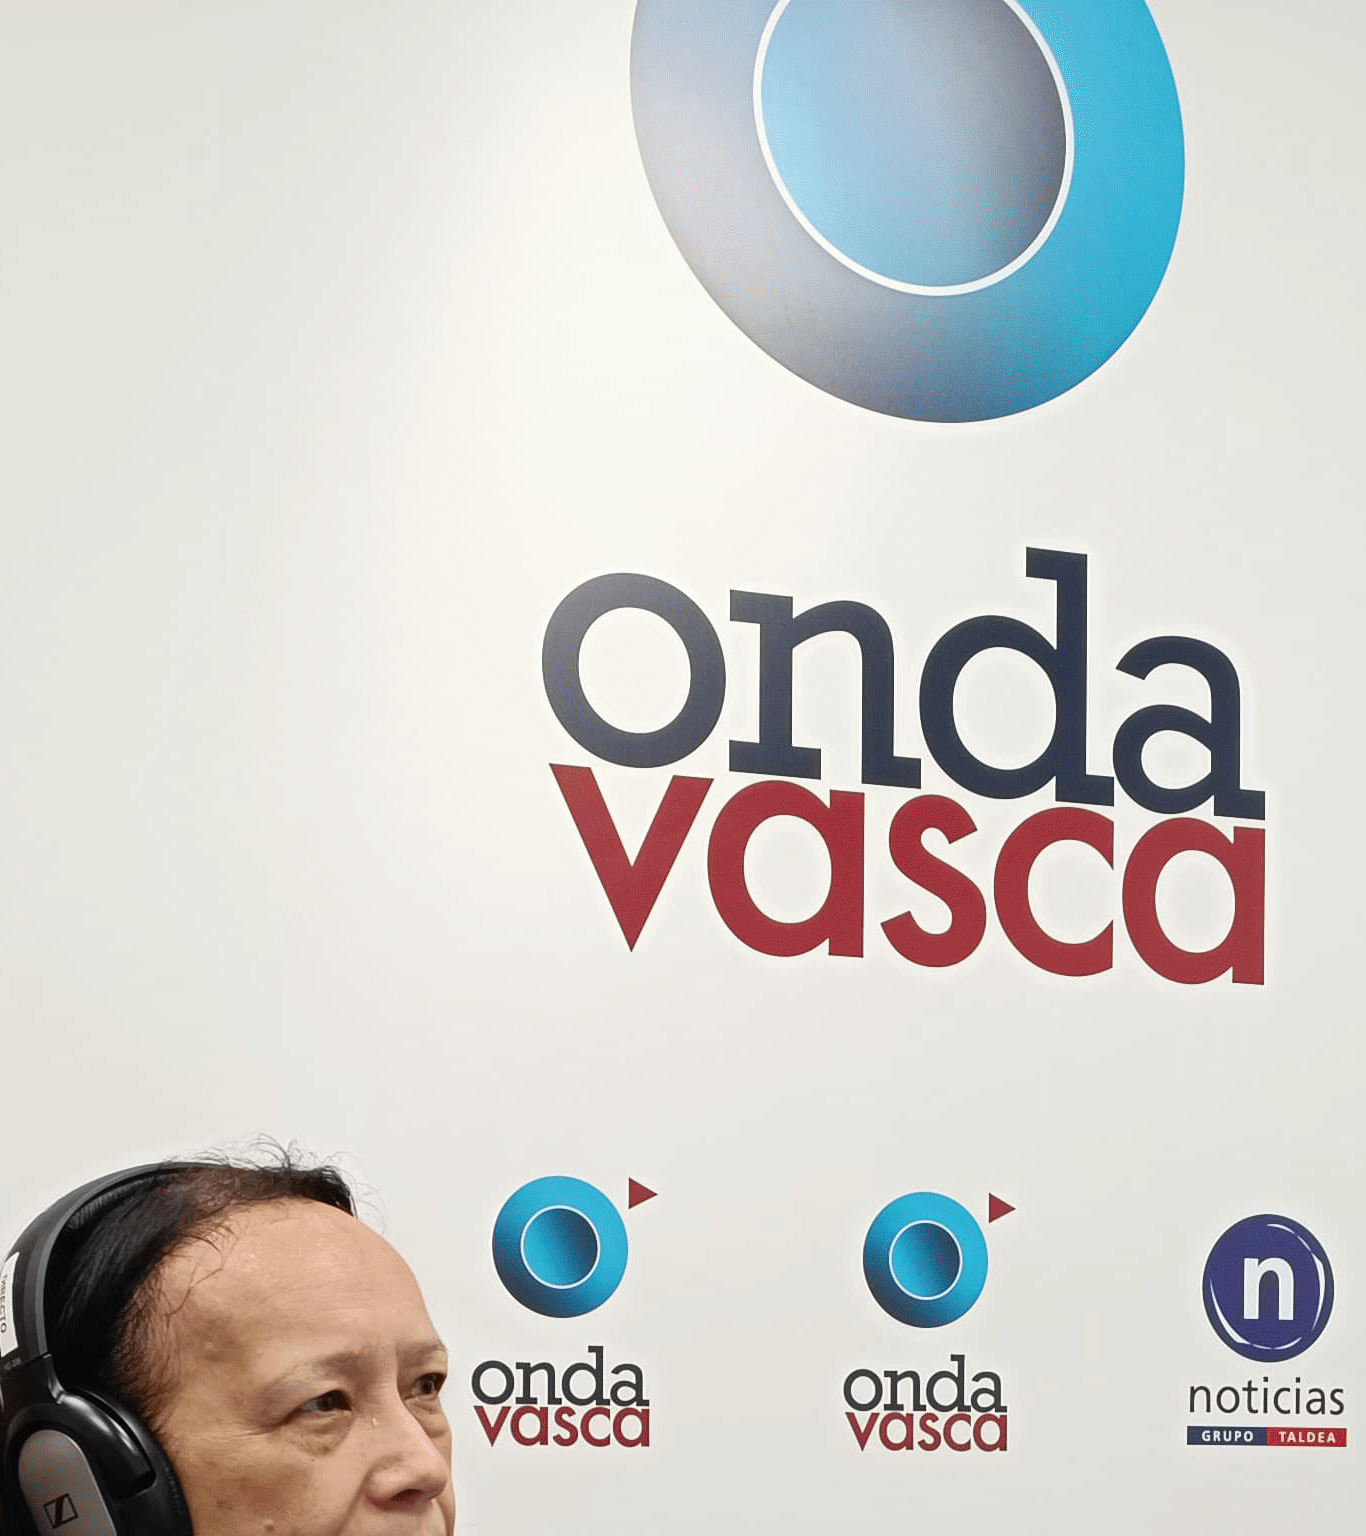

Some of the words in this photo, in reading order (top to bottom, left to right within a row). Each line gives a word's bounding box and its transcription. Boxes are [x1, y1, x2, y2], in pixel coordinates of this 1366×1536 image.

[542, 546, 1266, 821] onda
[549, 762, 1266, 986] vasca
[1243, 1256, 1295, 1321] n
[471, 1345, 651, 1407] onda
[843, 1354, 1008, 1413] onda
[1189, 1376, 1345, 1416] noticias
[474, 1403, 651, 1448] vasca
[845, 1410, 1008, 1453] vasca
[1201, 1430, 1254, 1442] GRUPO
[1278, 1431, 1336, 1443] TALDEA
